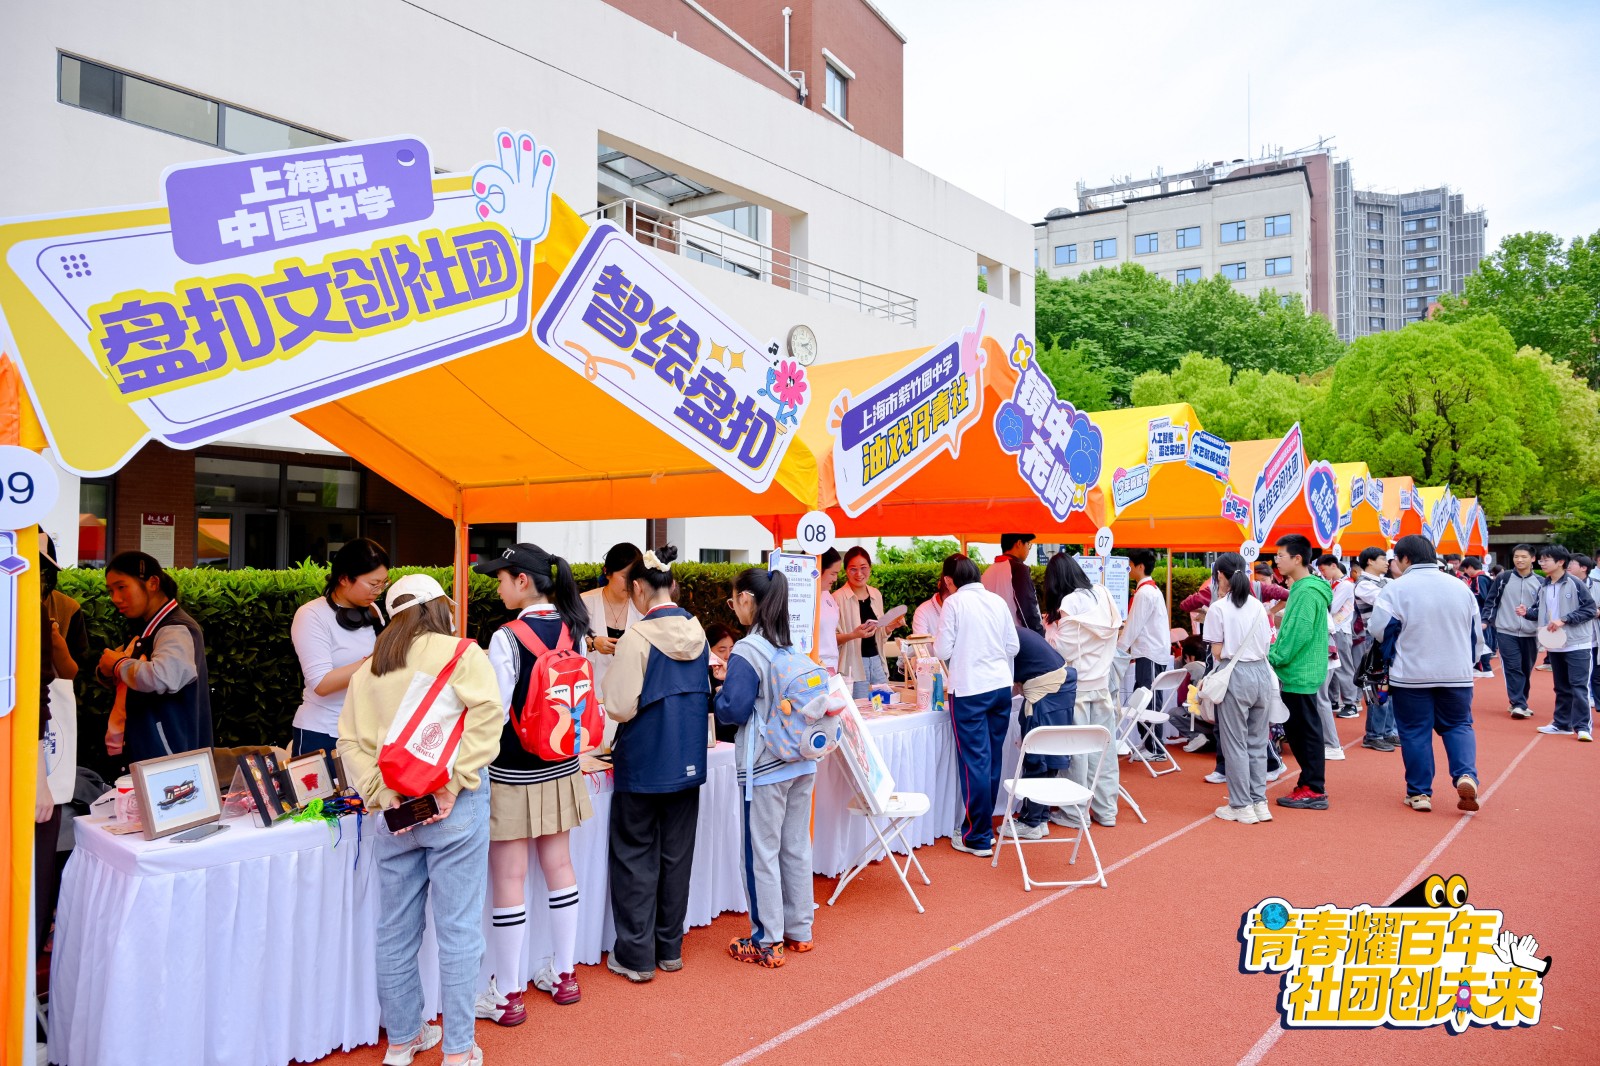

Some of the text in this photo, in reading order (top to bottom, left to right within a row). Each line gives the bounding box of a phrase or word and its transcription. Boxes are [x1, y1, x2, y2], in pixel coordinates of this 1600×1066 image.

[241, 154, 366, 205] 上海市
[217, 185, 396, 249] 中国中学
[100, 227, 519, 395] 盘扣文创社团
[581, 264, 777, 470] 智绘盘扣
[859, 353, 953, 434] 上海市紫竹园中学
[862, 373, 969, 486] 油戏丹青社
[1151, 432, 1174, 444] 人工智能
[0, 472, 34, 504] 9
[804, 524, 826, 542] 08
[1098, 536, 1110, 548] 07
[1244, 547, 1255, 556] 06
[412, 743, 435, 759] CORNELL
